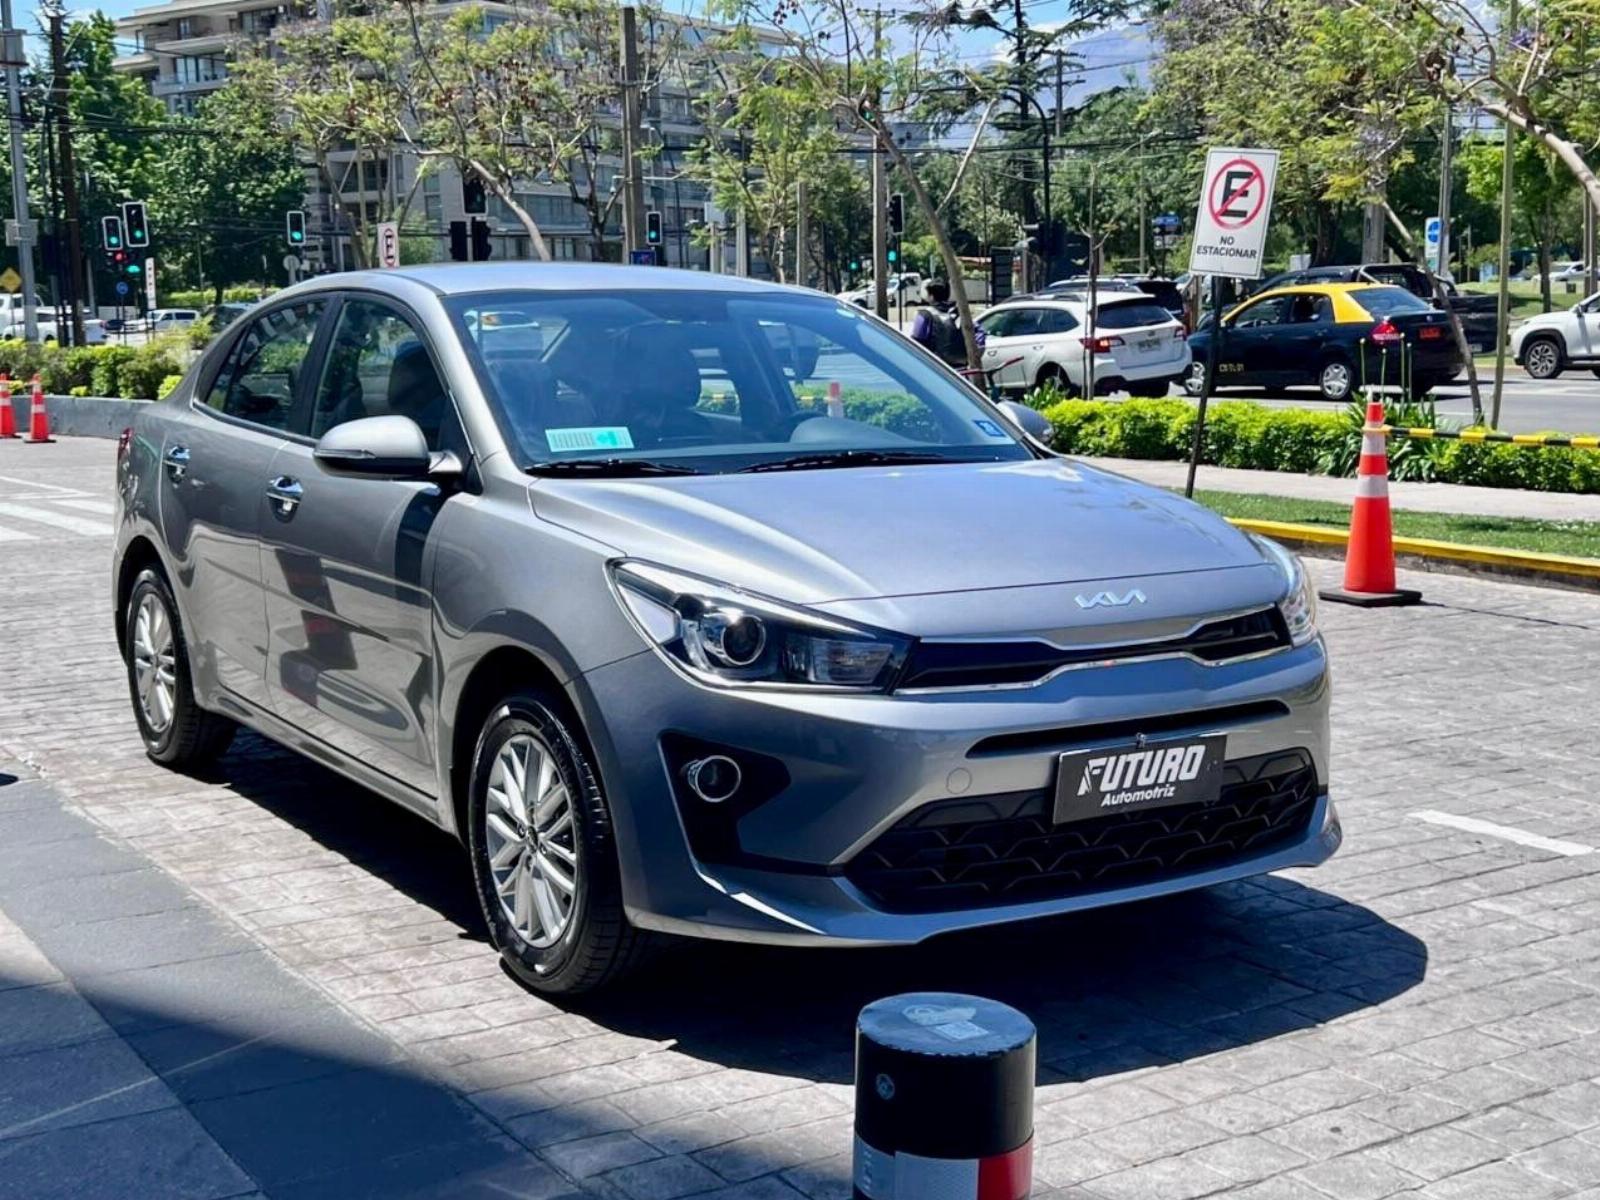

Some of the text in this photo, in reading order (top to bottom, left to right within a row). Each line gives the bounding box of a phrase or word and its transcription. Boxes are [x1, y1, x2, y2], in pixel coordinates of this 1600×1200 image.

[1220, 236, 1235, 246] NO
[1197, 245, 1257, 259] ESTACIONAR
[1077, 745, 1206, 796] FUTURO
[1101, 783, 1176, 807] Automotriz
